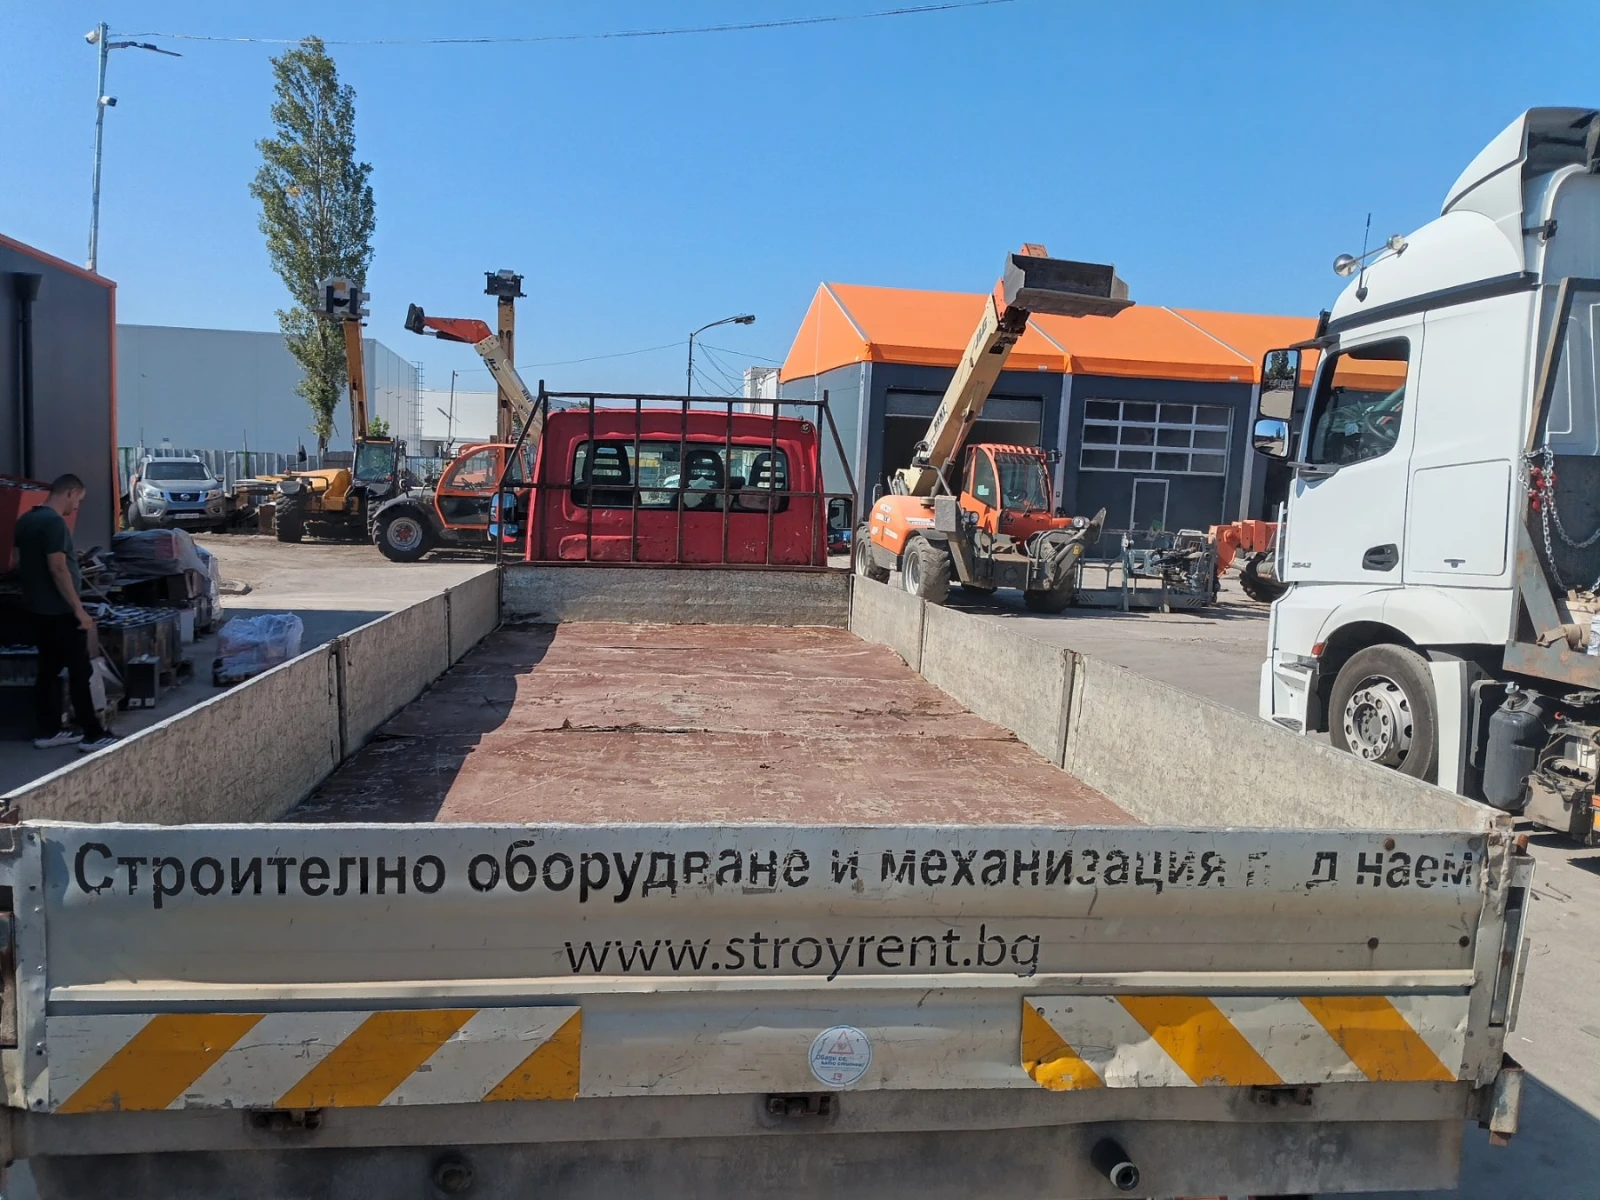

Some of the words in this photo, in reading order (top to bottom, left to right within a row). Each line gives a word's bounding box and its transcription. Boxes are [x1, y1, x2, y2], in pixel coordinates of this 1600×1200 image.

[74, 842, 446, 909] Строително
[468, 840, 810, 903] оборудване
[831, 849, 859, 885] и
[881, 848, 1227, 895] механизация
[1356, 851, 1473, 889] наем
[564, 923, 1041, 982] www.stroyrent.bg
